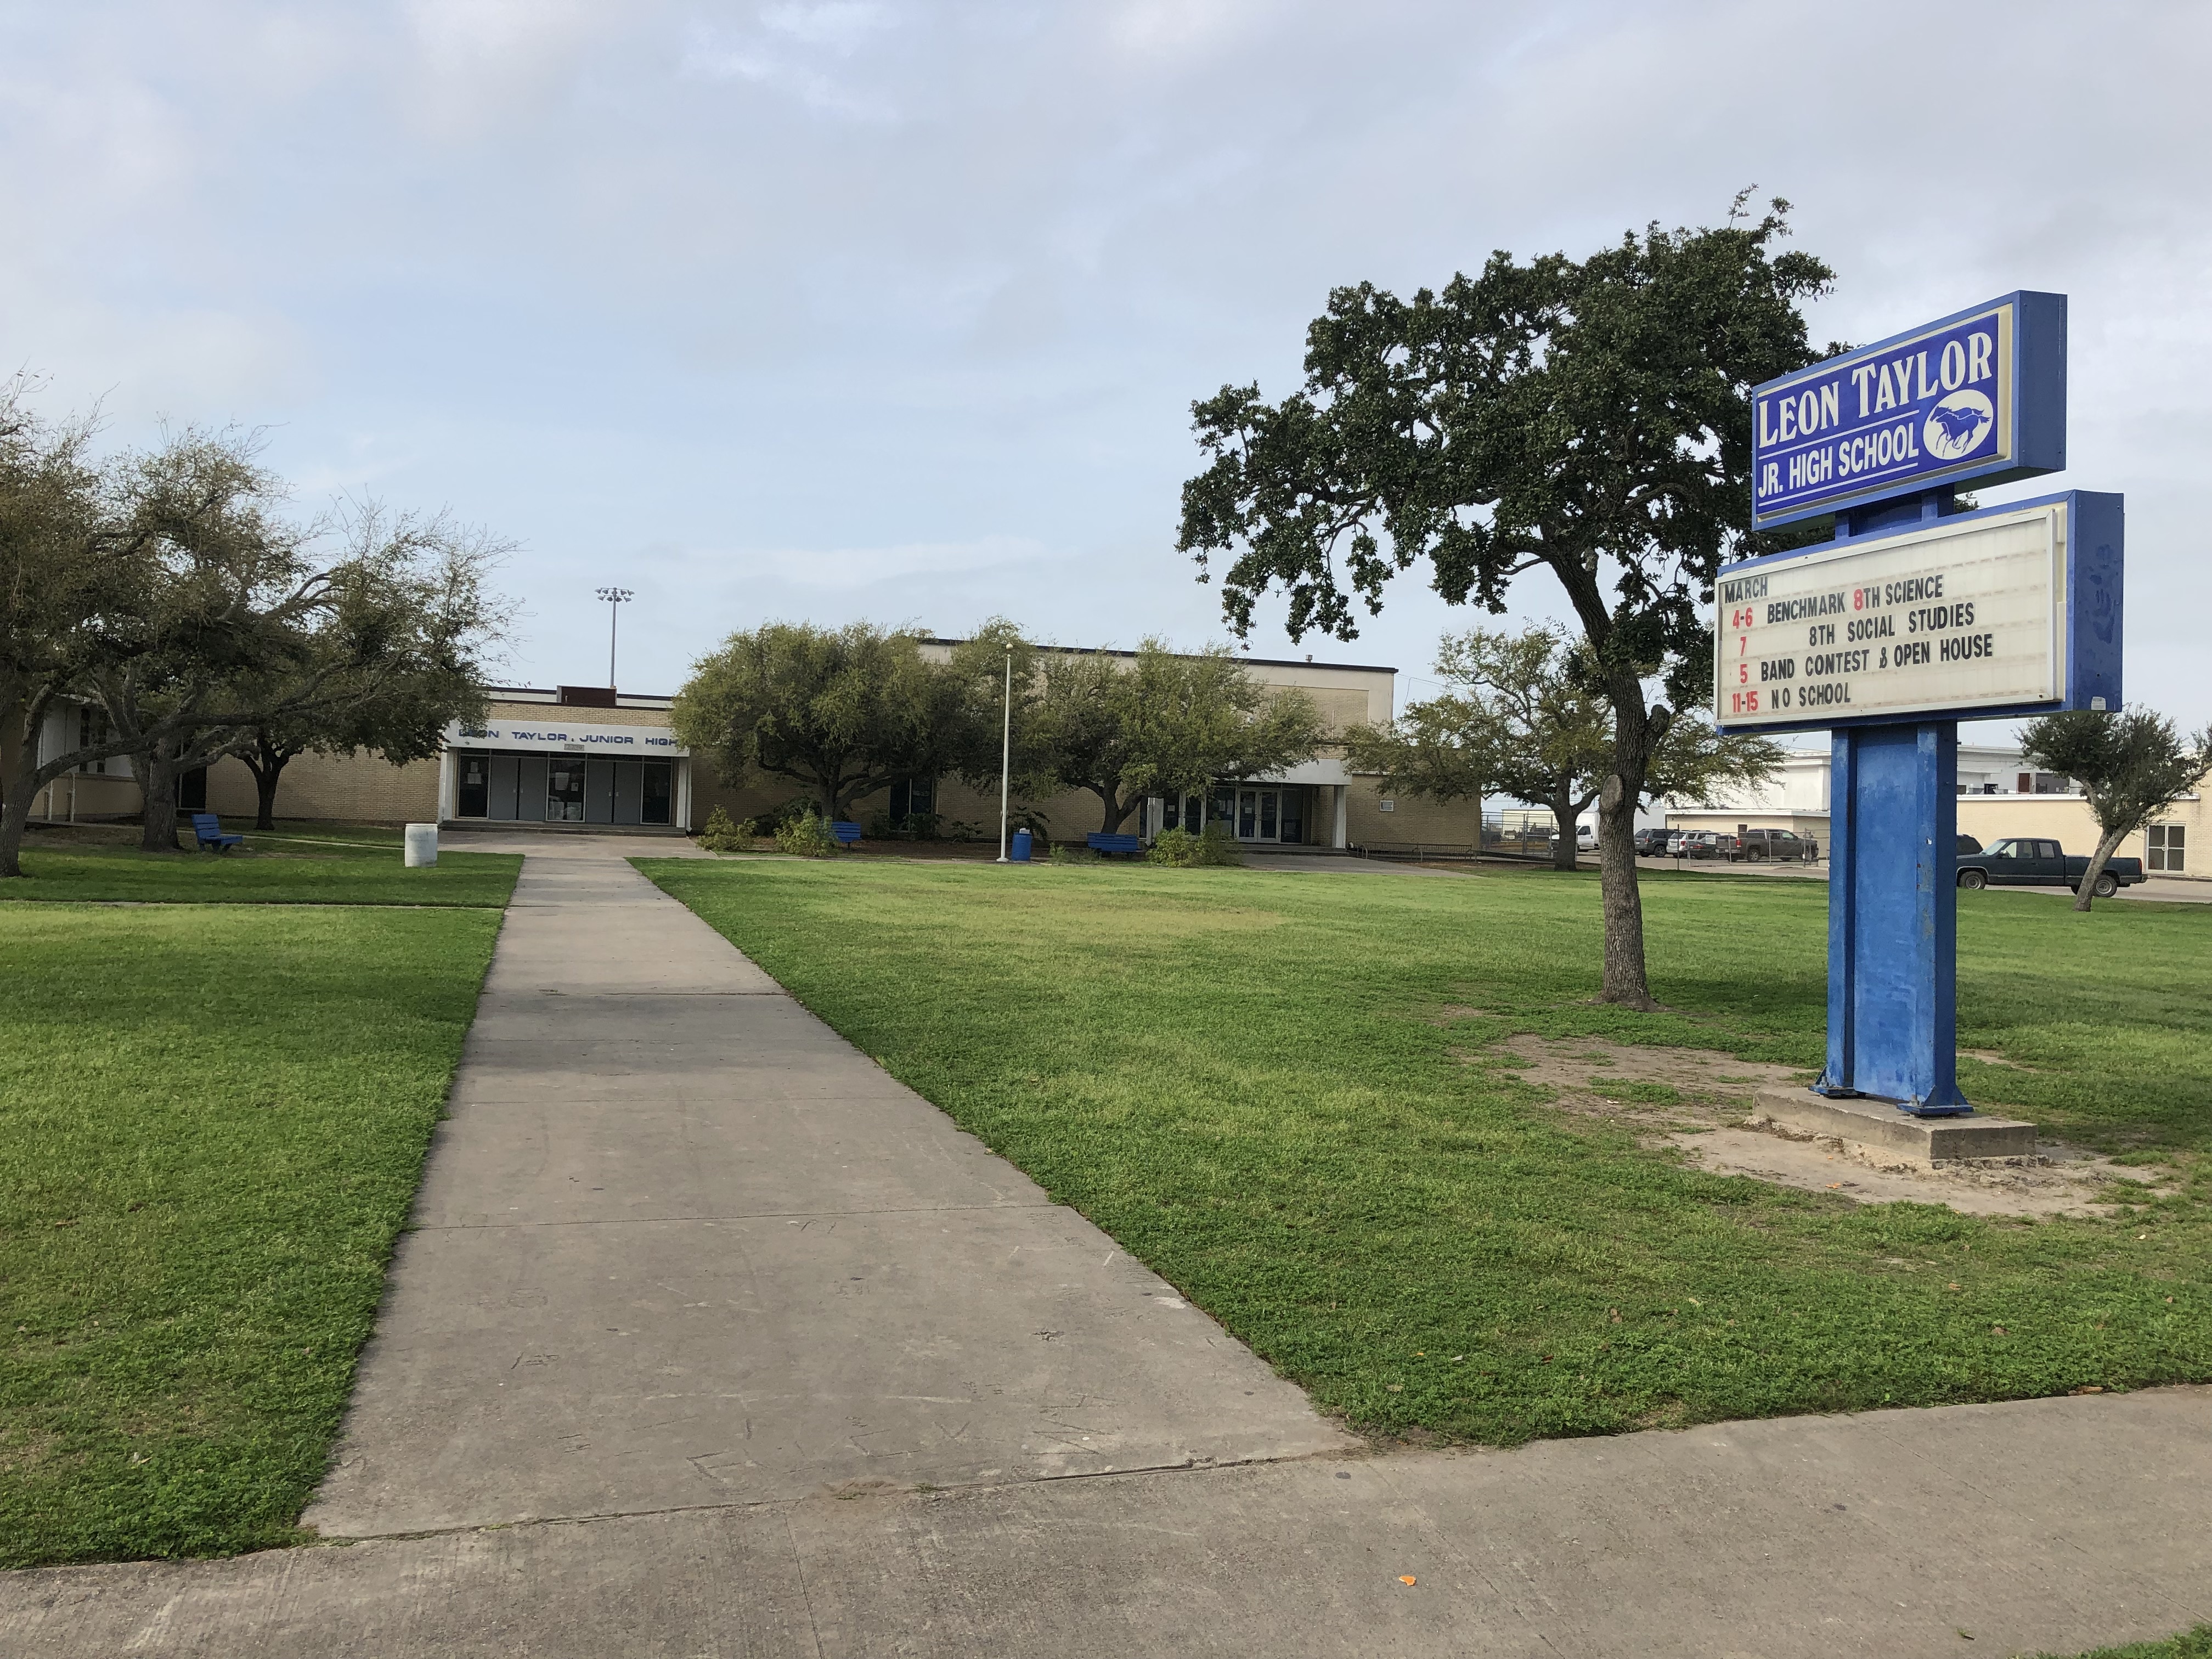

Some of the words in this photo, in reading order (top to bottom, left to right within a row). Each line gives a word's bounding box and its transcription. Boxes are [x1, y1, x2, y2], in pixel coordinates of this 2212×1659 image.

[1758, 381, 1839, 449] LEON
[1851, 332, 1993, 419] TAYLOR
[1758, 462, 1784, 498] JR.
[1789, 445, 1833, 485] HIGH
[1838, 422, 1919, 477] SCHOOL
[1724, 576, 1768, 604] MARCH
[1732, 607, 1753, 629] 4-6
[1767, 591, 1846, 624] BENCHMARK
[1853, 585, 1880, 611] 8TH
[1885, 574, 1943, 606] SCIENCE
[1740, 636, 1747, 657] 7
[1809, 623, 1835, 647] 8TH
[1847, 614, 1895, 642] SOCIAL
[1908, 602, 1974, 633] STUDIES
[1740, 663, 1748, 684] 5
[1760, 658, 1795, 682] BAND
[1805, 649, 1870, 677] CONTEST
[1878, 646, 1888, 669] &
[1893, 641, 1931, 668] OPEN
[1940, 633, 1993, 662] HOUSE
[1732, 691, 1759, 713] 11-15
[1771, 687, 1791, 709] NO
[1798, 682, 1851, 707] SCHOOL
[459, 729, 499, 738] LEN
[511, 731, 567, 741] TAYLOR
[579, 735, 634, 744] JUNIOR
